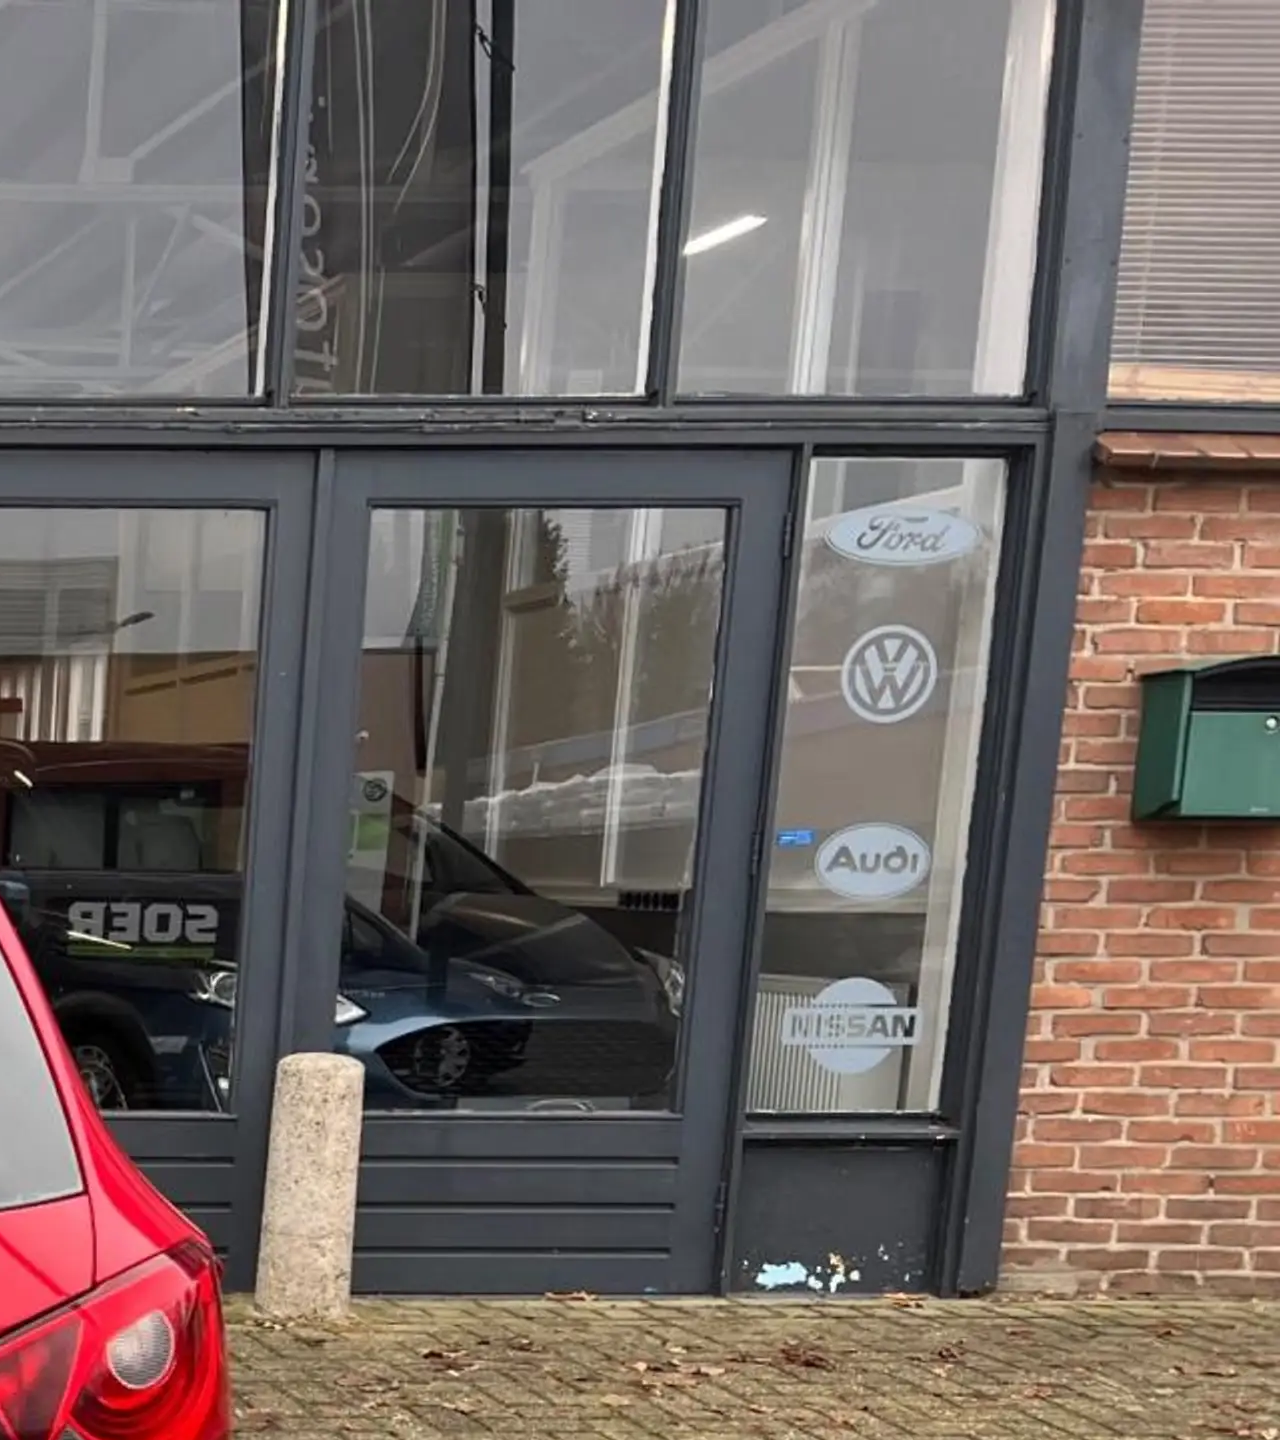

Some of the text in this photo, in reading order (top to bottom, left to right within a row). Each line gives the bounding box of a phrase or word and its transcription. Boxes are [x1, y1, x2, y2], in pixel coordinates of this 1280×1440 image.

[856, 512, 951, 552] Ford
[825, 845, 919, 874] Audi
[790, 1013, 916, 1038] NISSAN
